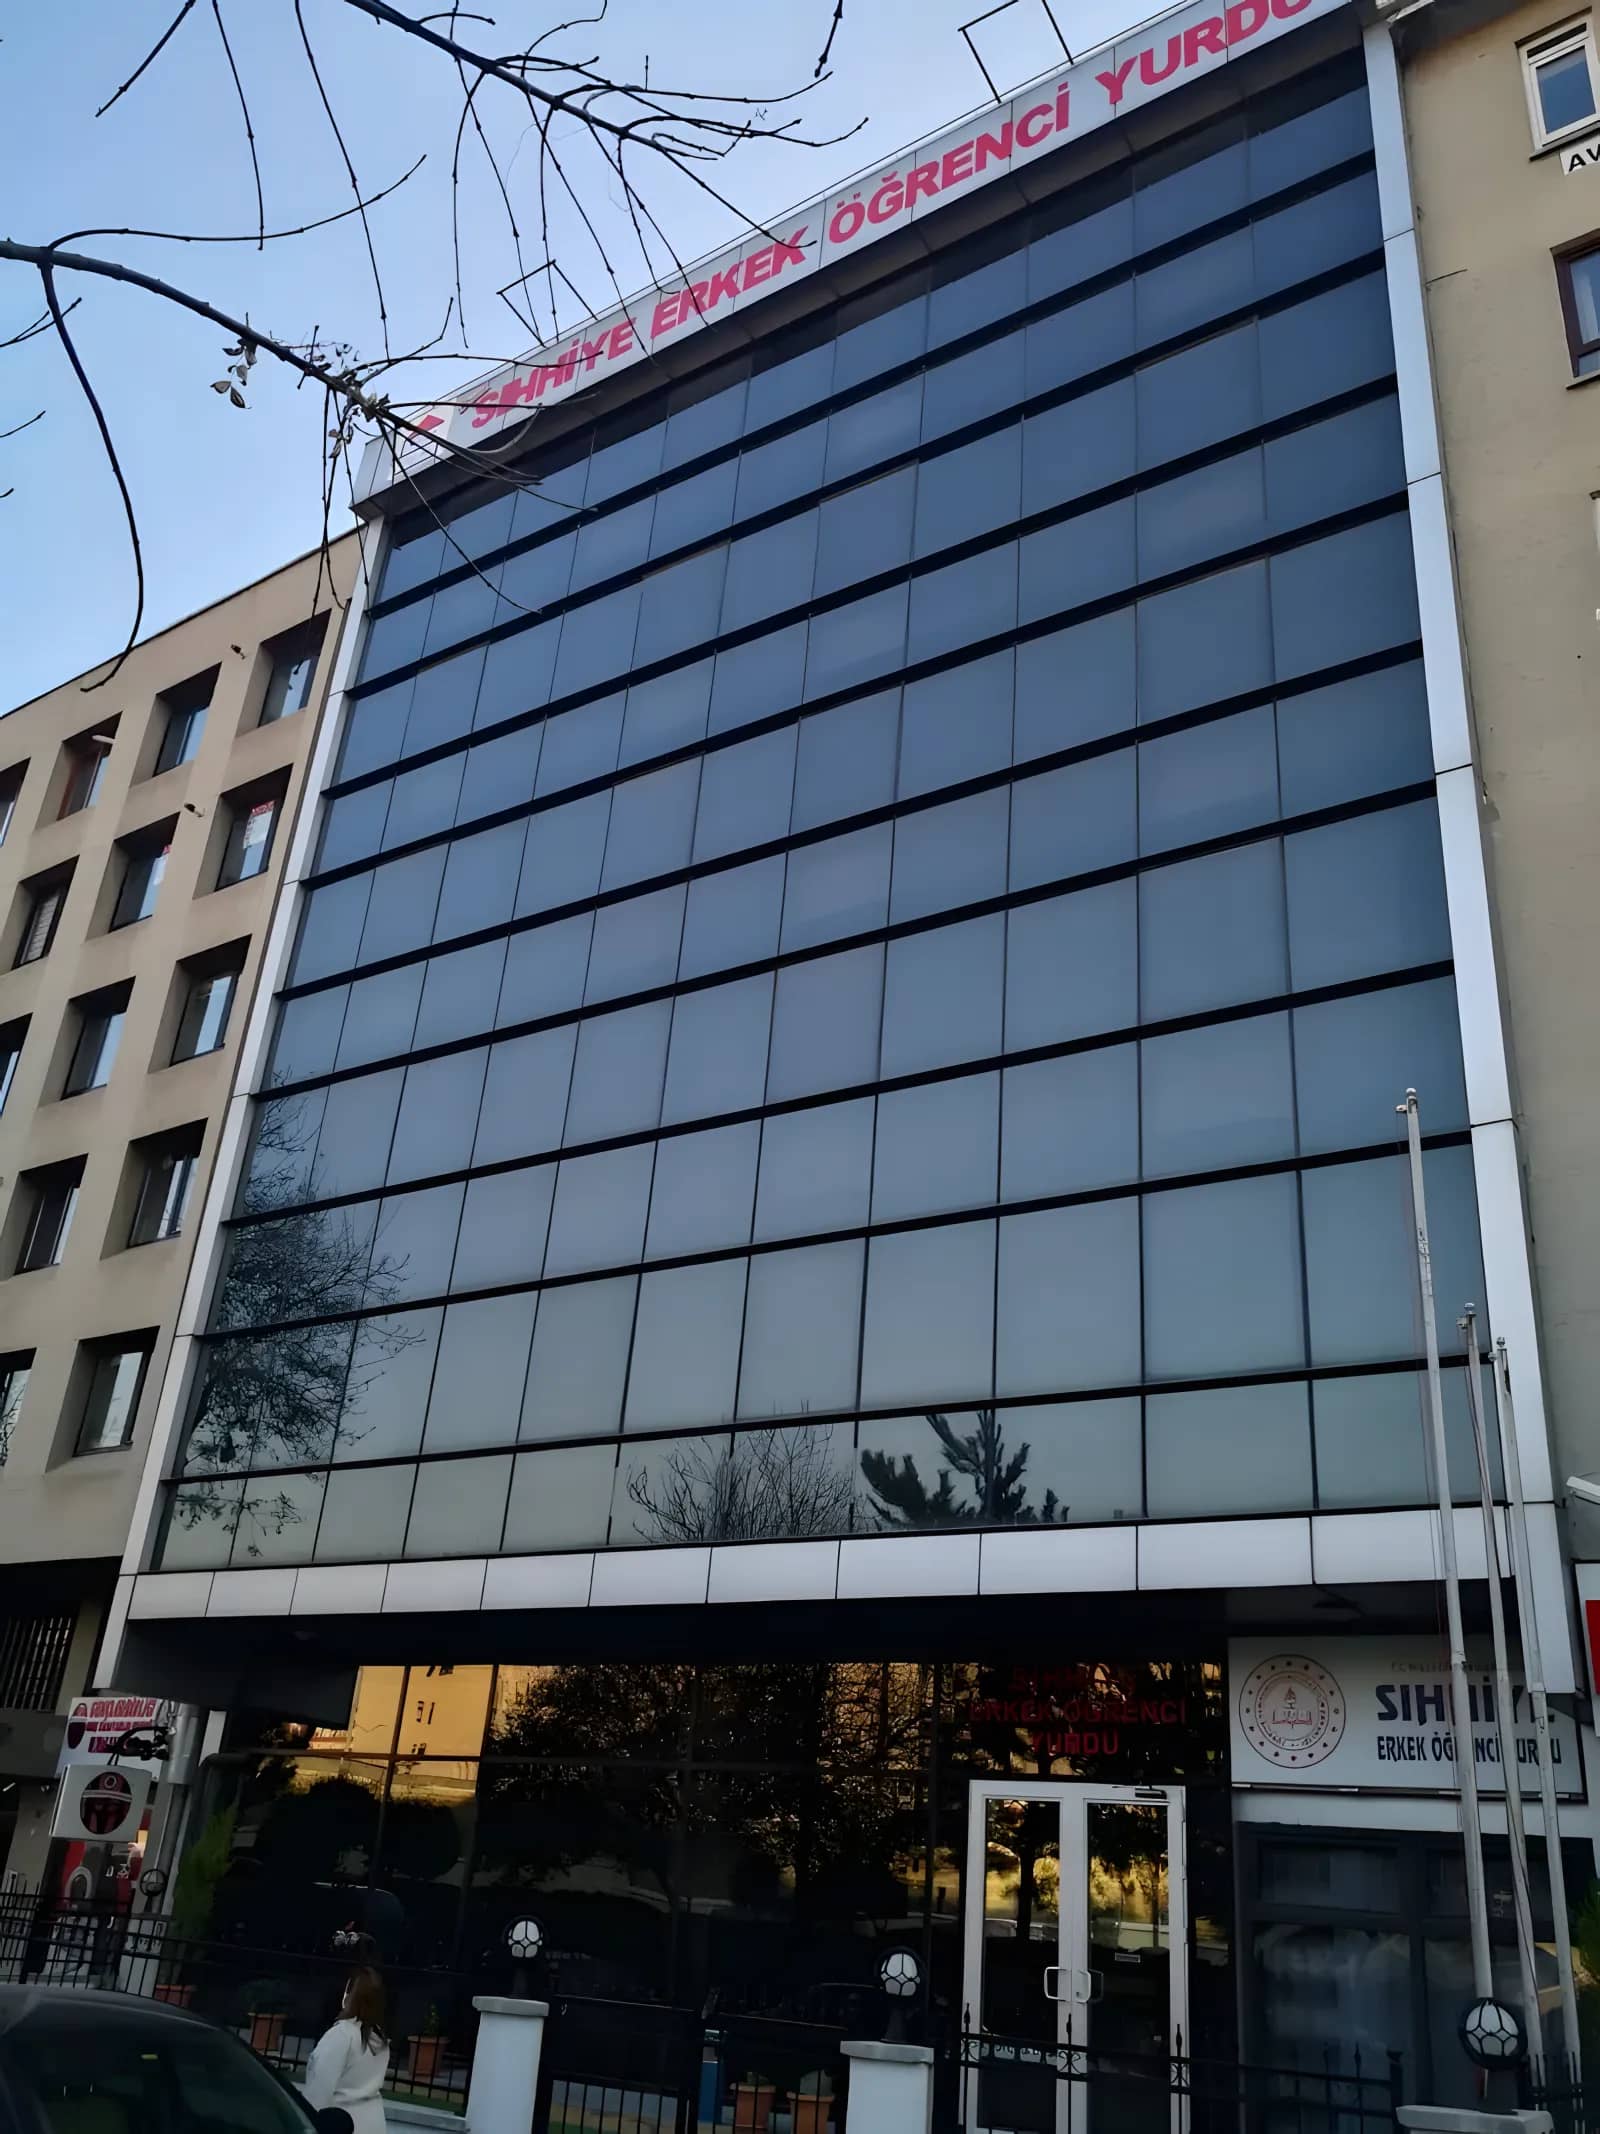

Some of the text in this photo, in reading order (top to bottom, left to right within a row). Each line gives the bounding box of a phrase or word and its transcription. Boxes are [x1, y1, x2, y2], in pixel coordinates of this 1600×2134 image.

[650, 225, 809, 338] ERKEK
[828, 83, 1070, 243] ÖĞRENCİ
[1377, 1735, 1427, 1762] ERKEK
